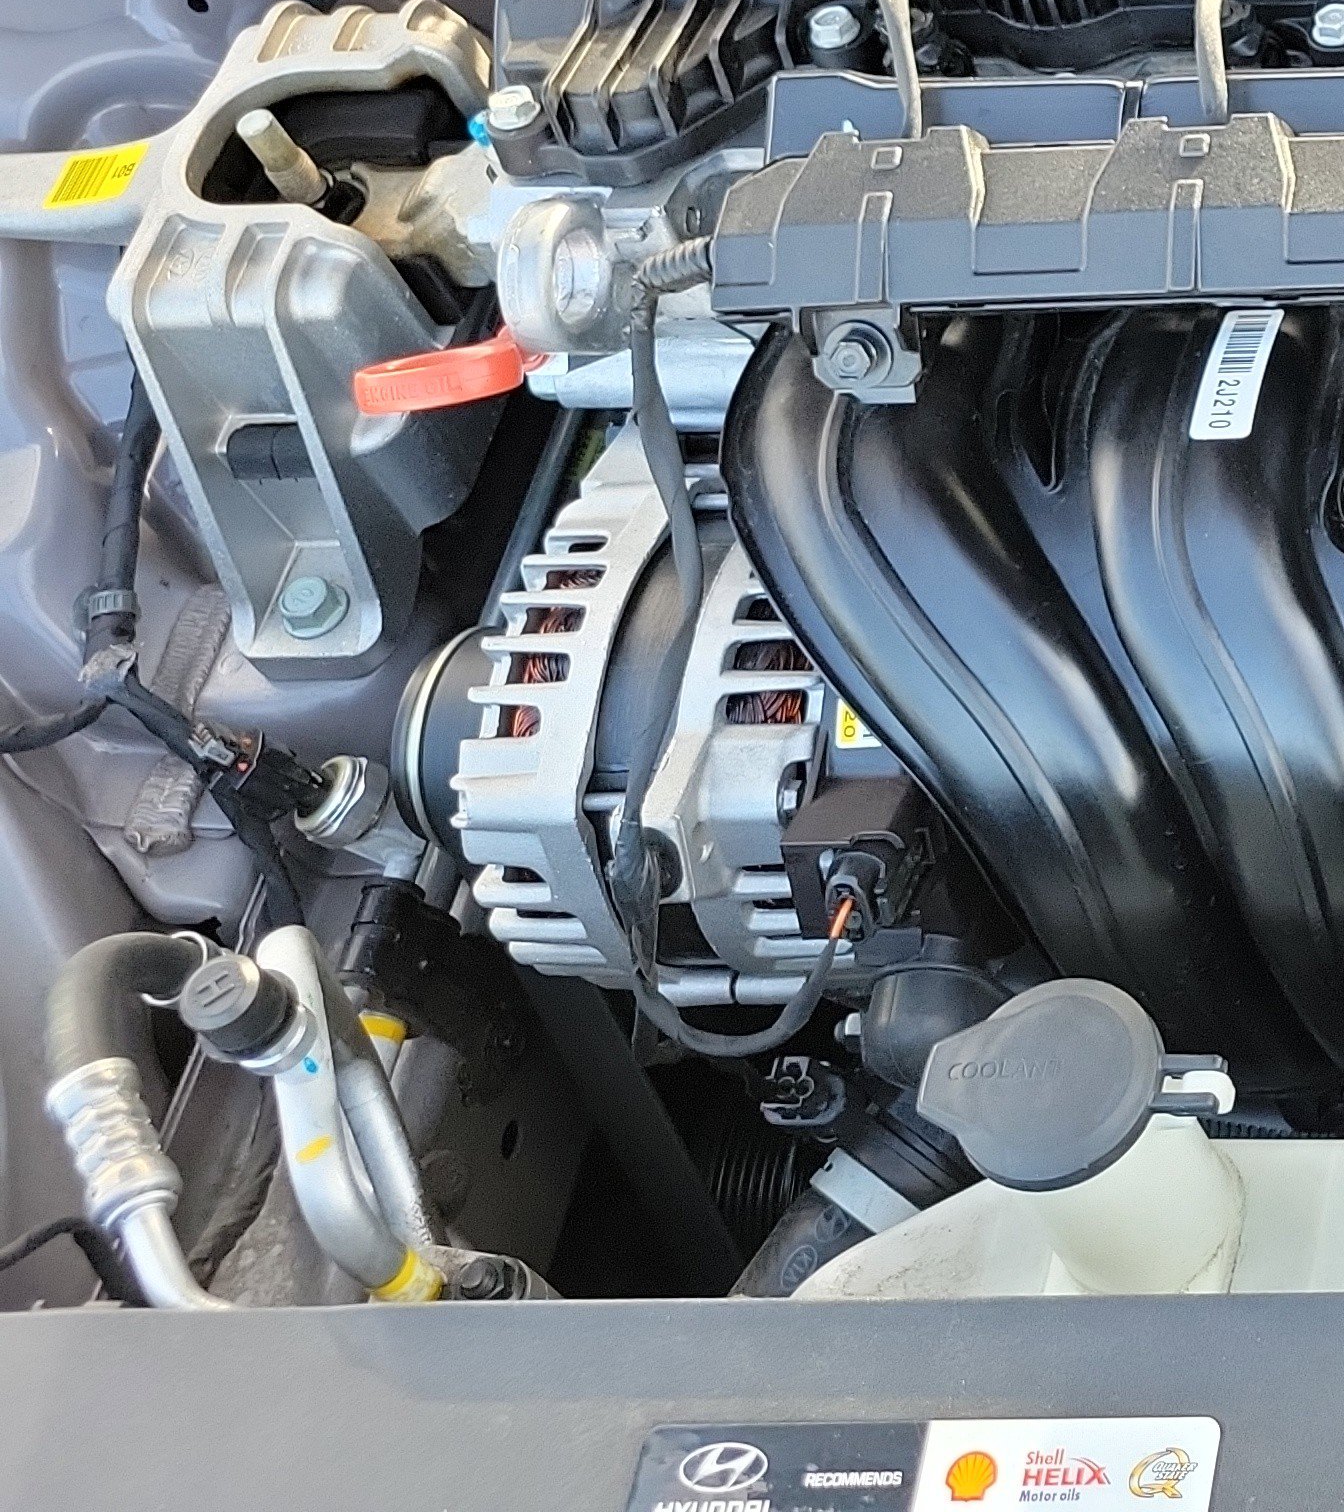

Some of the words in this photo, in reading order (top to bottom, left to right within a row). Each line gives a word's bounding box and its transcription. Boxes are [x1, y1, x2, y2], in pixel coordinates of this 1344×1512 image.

[1208, 379, 1241, 429] 2J210
[948, 1059, 1063, 1082] COOLANT
[1026, 1448, 1065, 1465] Shell
[1152, 1461, 1198, 1473] QUAKER
[804, 1471, 903, 1488] RECOMMENDS
[1022, 1466, 1108, 1487] HELIX
[1155, 1471, 1189, 1481] STATE
[1019, 1489, 1057, 1502] Motor
[1059, 1488, 1080, 1501] oils
